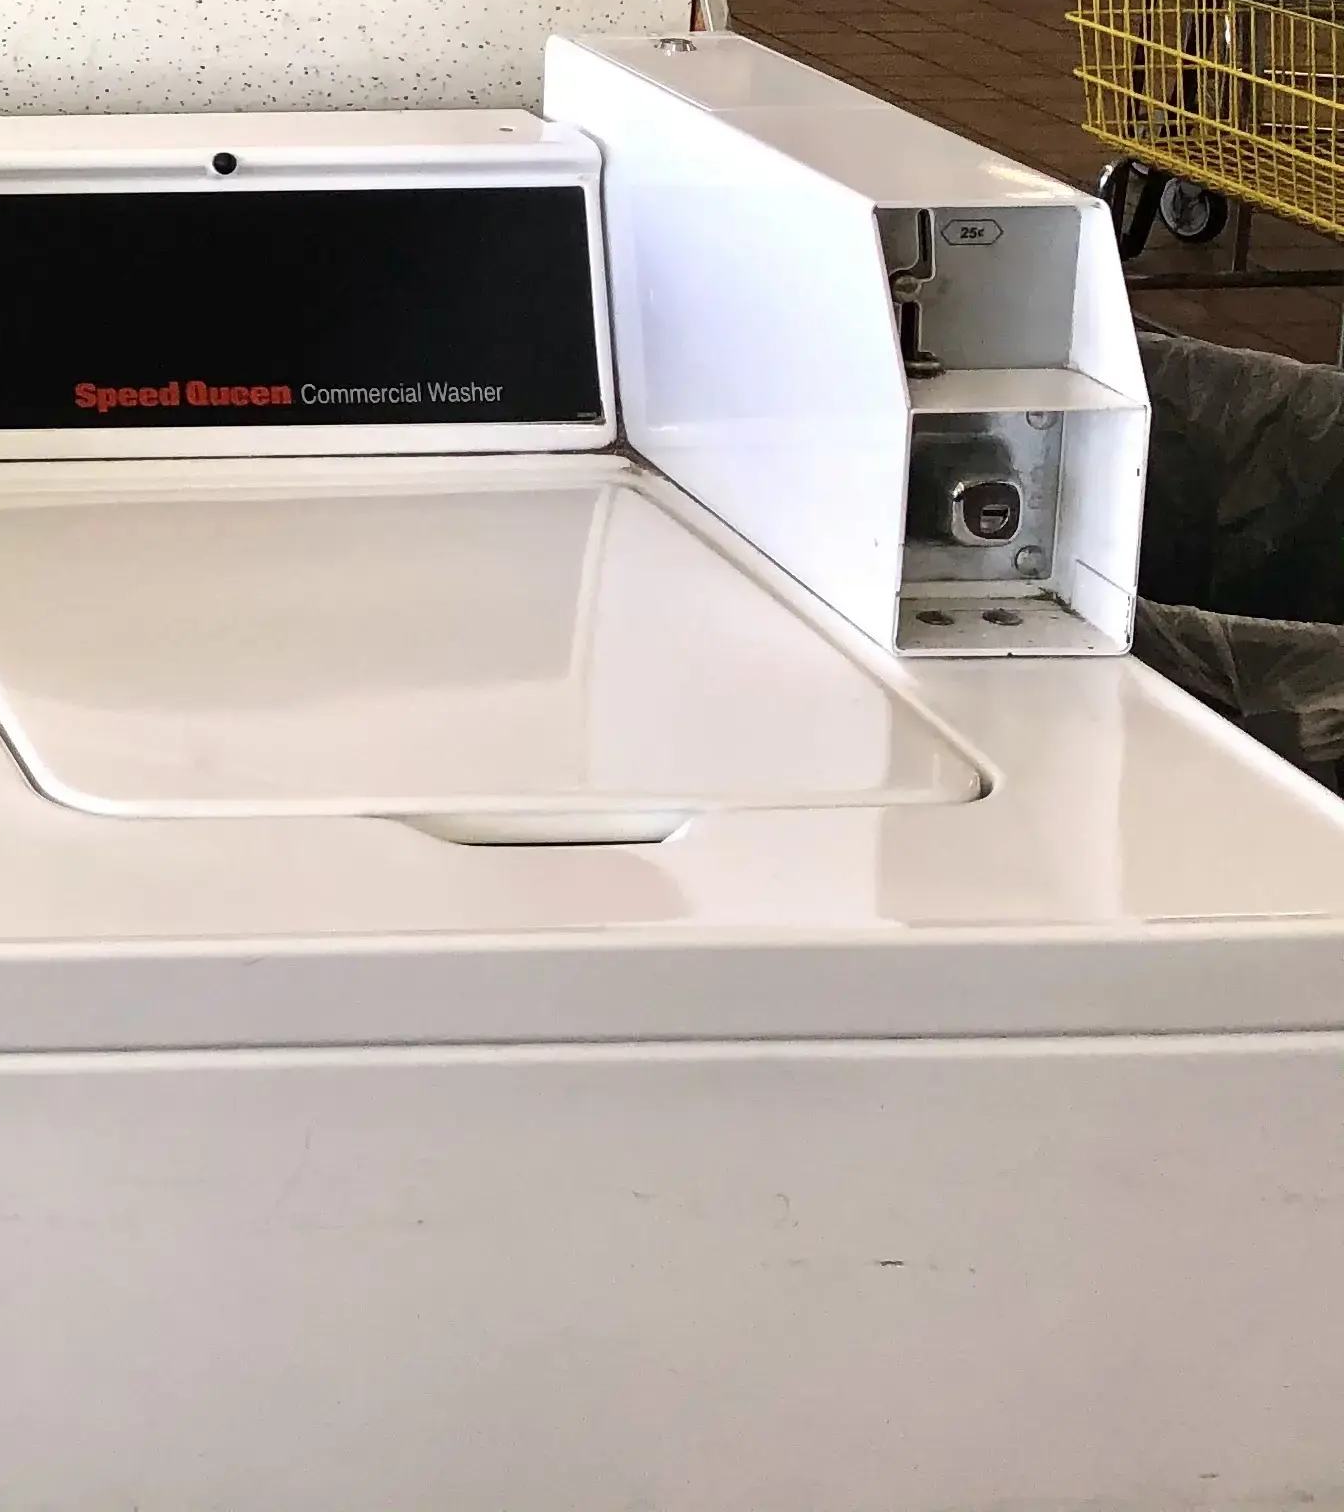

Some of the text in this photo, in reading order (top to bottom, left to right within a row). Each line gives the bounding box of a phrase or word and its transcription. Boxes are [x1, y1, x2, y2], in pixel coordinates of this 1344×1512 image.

[74, 379, 503, 413] Speed Queen Commercial Washer
